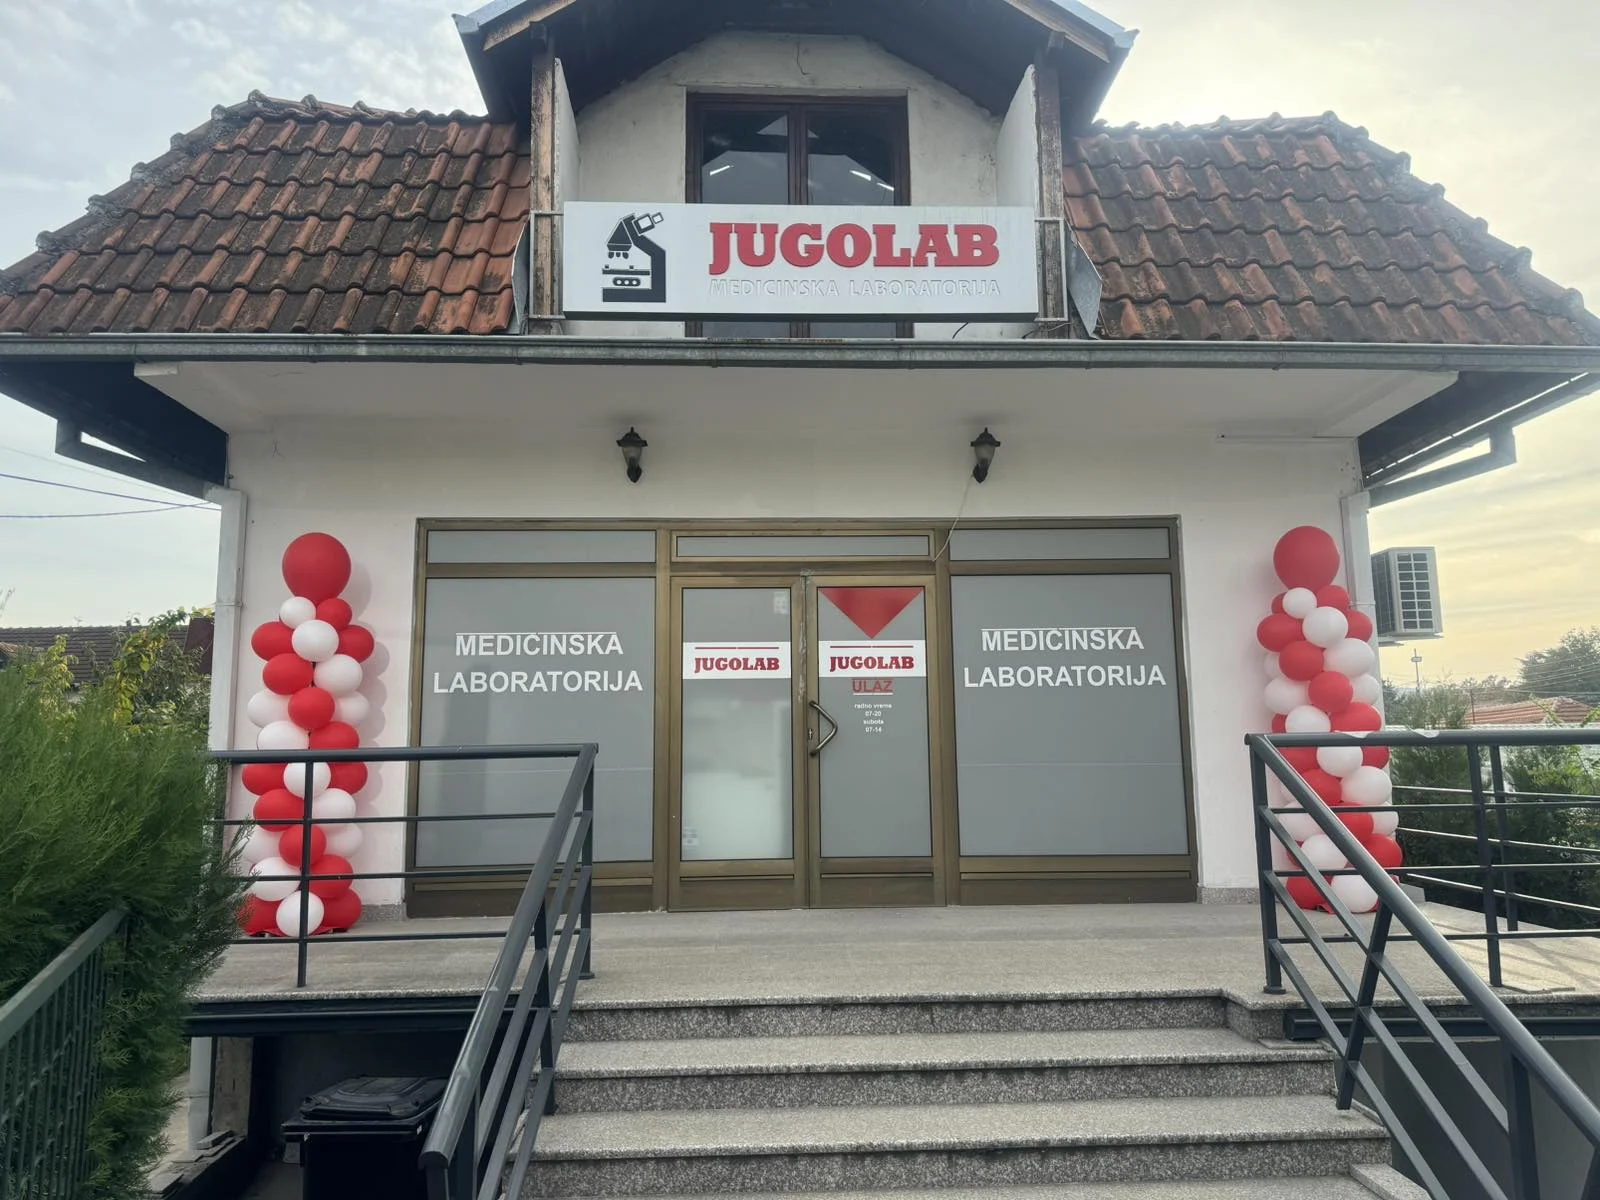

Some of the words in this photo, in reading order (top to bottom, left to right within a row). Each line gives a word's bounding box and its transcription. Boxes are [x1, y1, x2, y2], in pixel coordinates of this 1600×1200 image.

[709, 222, 1000, 275] JUGOLAB
[709, 278, 840, 297] MEDICINSKA
[849, 279, 1001, 297] LABORATORIJA
[455, 634, 624, 656] MEDICINSKA
[981, 629, 1145, 651] MEDICINSKA
[694, 657, 780, 673] JUGOLAB
[829, 656, 915, 672] JUGOLAB
[433, 670, 643, 693] LABORATORIJA
[852, 678, 893, 693] ULAZ
[963, 665, 1167, 687] LABORATORIJA
